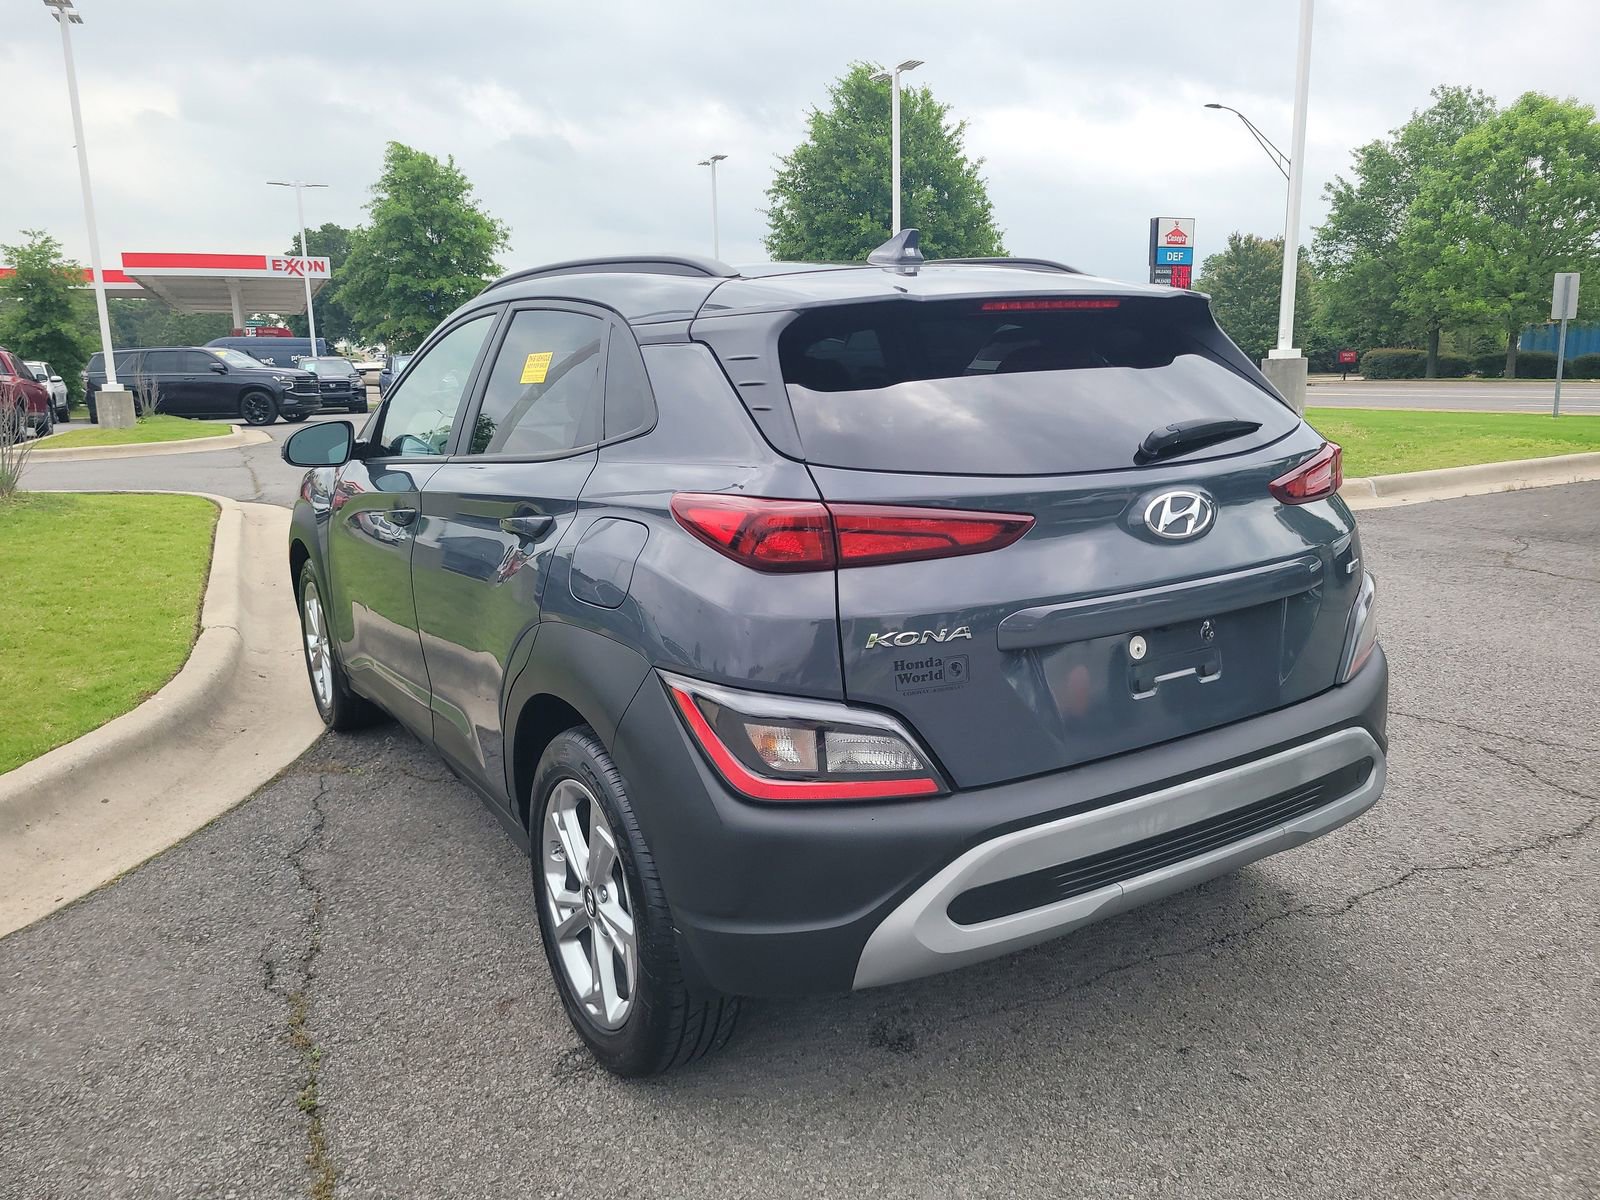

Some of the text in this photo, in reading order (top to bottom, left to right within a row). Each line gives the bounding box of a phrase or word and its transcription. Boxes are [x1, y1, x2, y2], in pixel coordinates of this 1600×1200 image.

[1167, 234, 1186, 244] Casey's
[1166, 252, 1184, 261] DEF
[272, 258, 325, 276] EXXON
[865, 626, 973, 649] KONA
[894, 657, 943, 671] Honda
[897, 669, 944, 684] World
